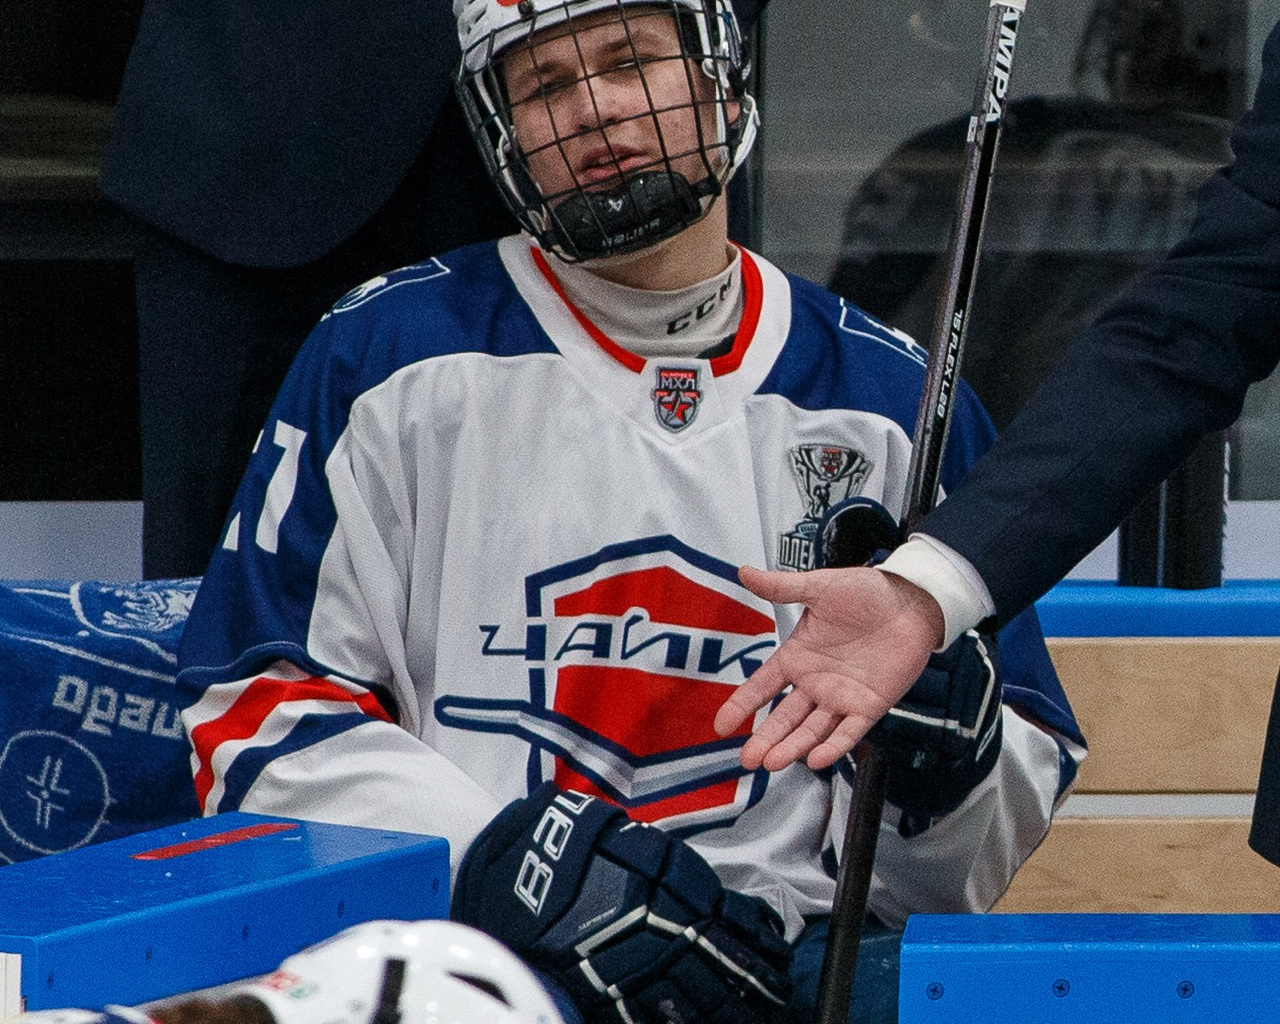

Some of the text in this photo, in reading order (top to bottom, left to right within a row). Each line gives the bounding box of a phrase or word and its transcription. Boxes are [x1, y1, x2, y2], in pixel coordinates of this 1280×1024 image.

[944, 332, 959, 379] FLEX
[660, 377, 696, 390] МХЛ
[221, 419, 309, 555] 7
